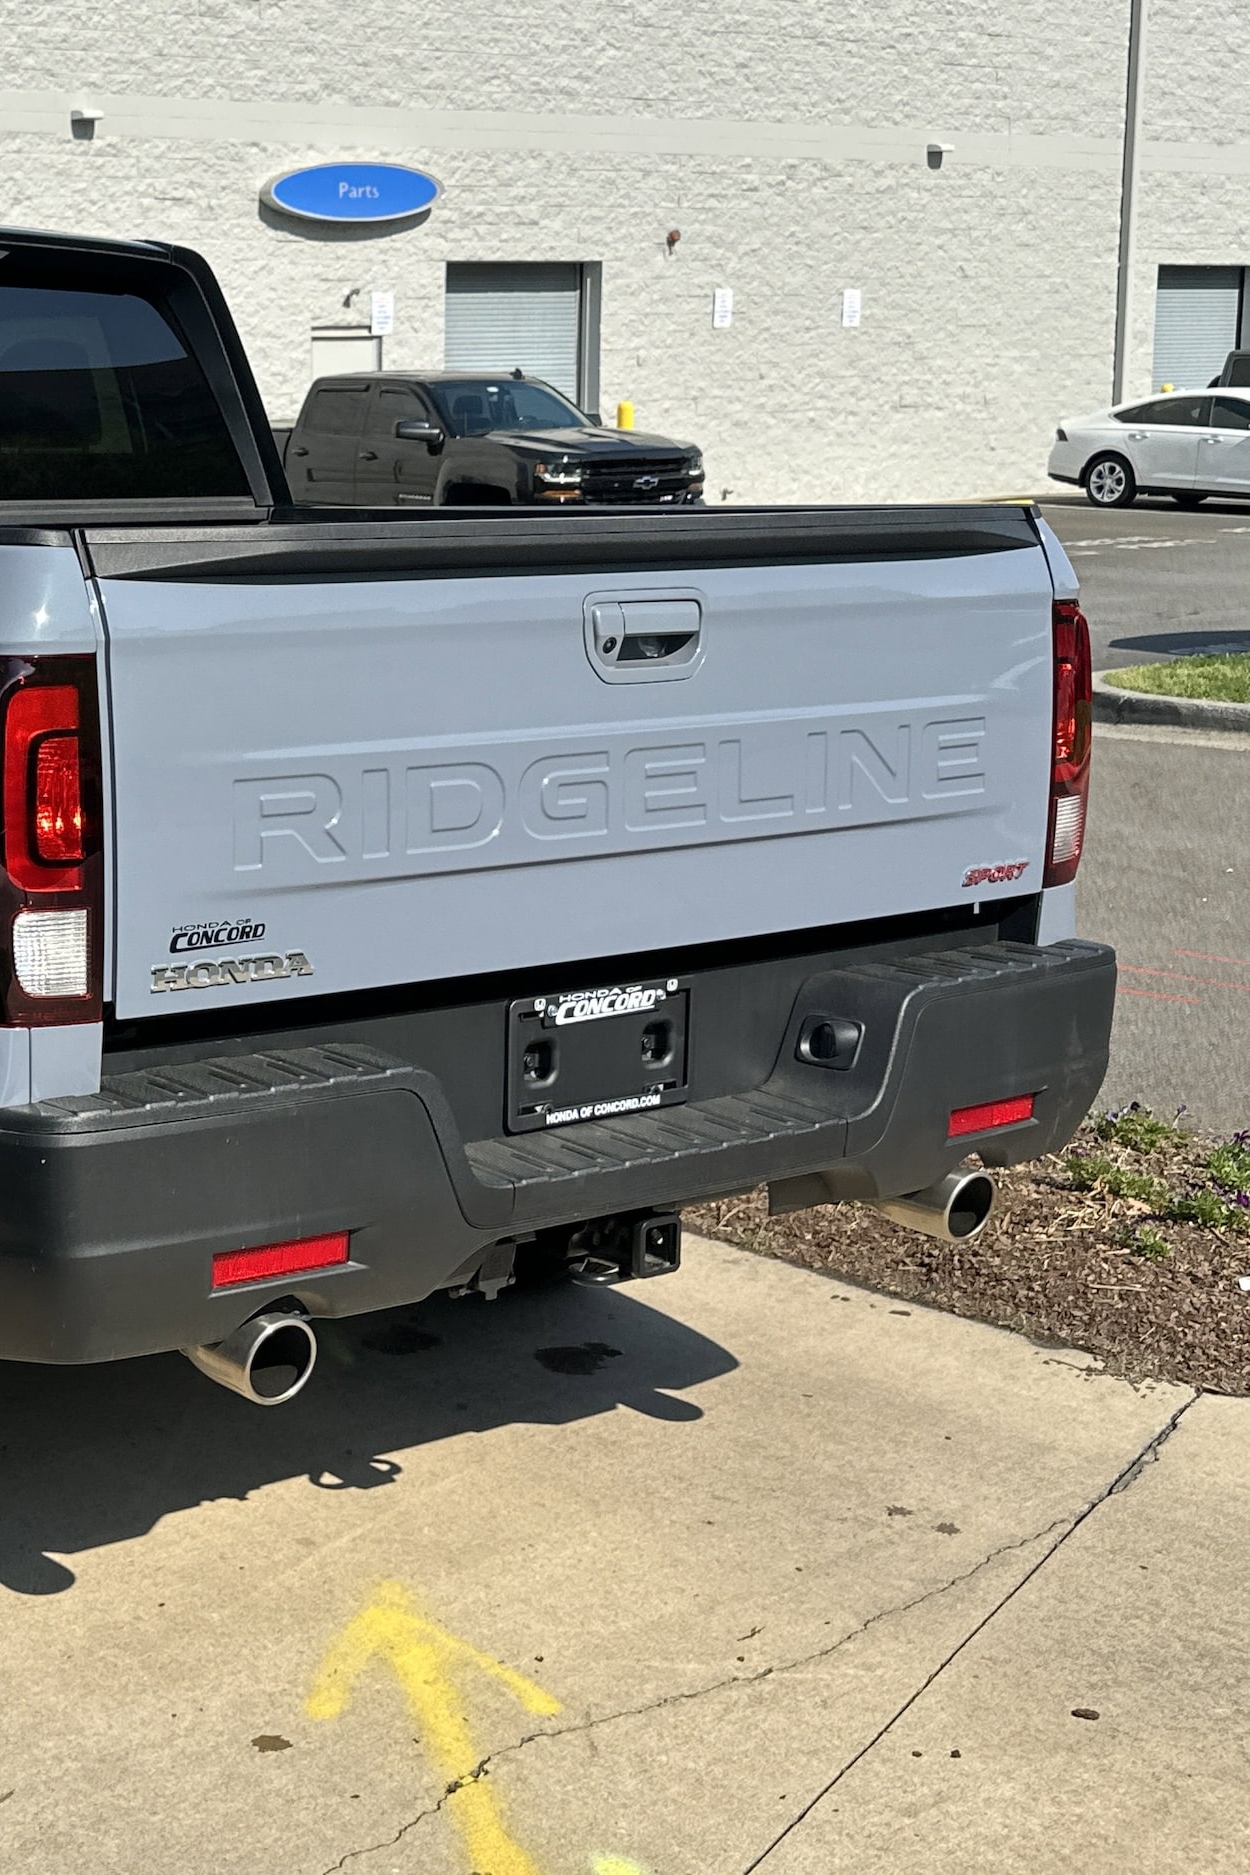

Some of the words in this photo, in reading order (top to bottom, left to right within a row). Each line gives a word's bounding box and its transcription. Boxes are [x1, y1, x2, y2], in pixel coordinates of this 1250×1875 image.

[338, 181, 380, 199] Parts
[232, 716, 987, 872] RIDGELINE
[961, 858, 1030, 888] SPORT
[169, 923, 266, 954] CONCORD
[172, 919, 231, 933] HONDA
[235, 918, 253, 926] OF
[150, 948, 316, 994] HONDA
[555, 988, 657, 1026] CONCORD
[559, 987, 623, 1003] HONDA
[545, 1110, 579, 1125] HONDA
[579, 1105, 594, 1118] OF
[594, 1094, 662, 1116] CONCORD.COM
